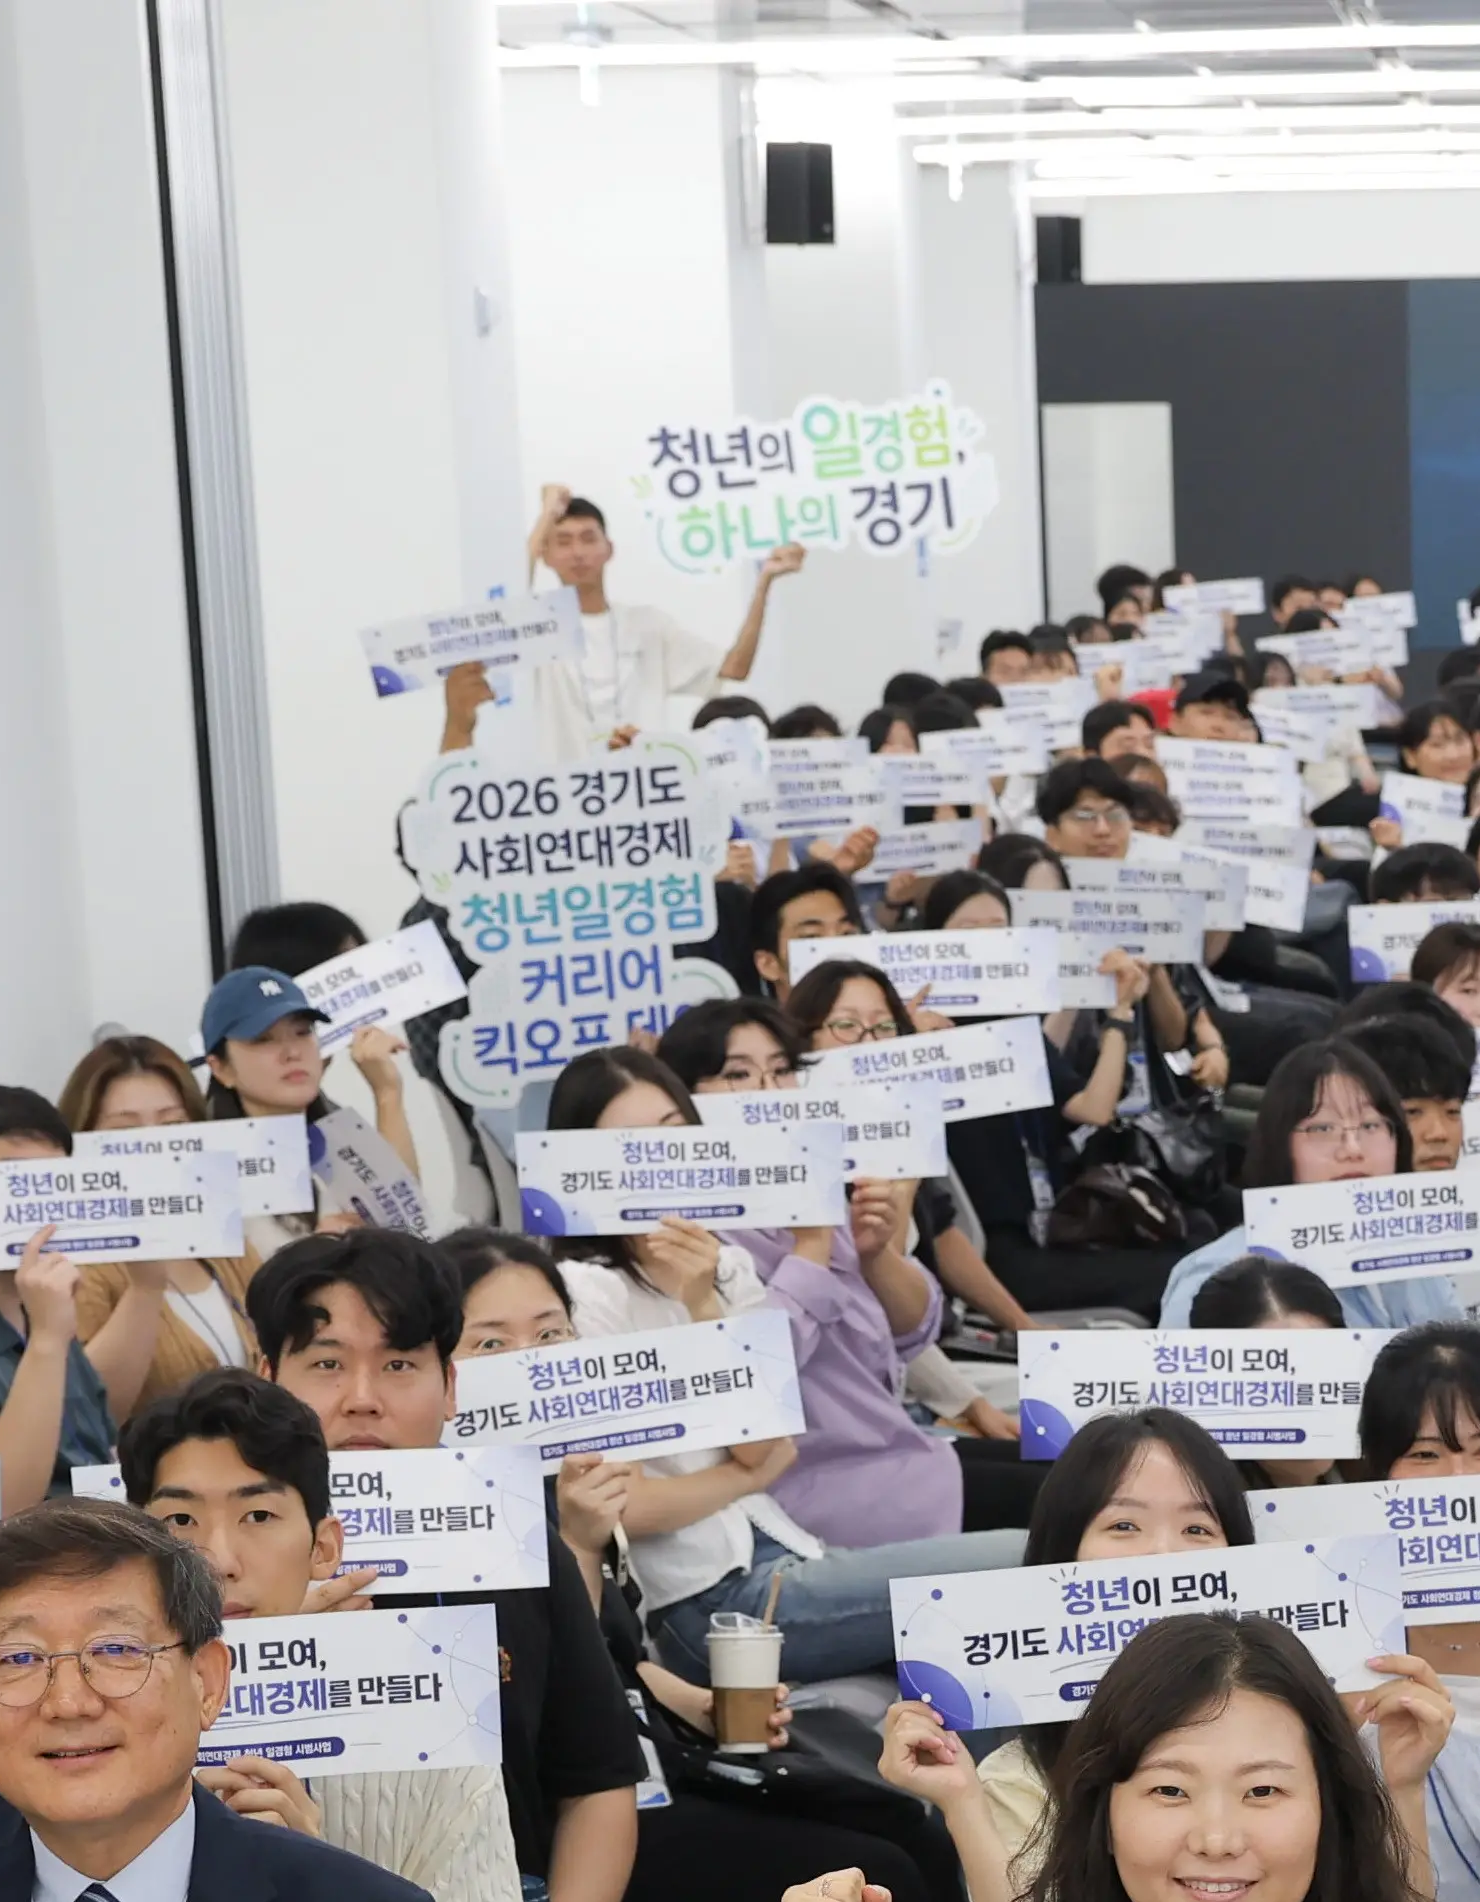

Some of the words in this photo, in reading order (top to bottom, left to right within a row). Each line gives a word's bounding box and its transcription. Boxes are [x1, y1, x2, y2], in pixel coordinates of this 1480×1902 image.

[648, 425, 795, 499] 청년의
[676, 494, 839, 559] 하나의
[850, 477, 953, 546] 경기
[451, 777, 560, 823] 2026
[570, 765, 685, 816] 경기도
[454, 817, 692, 879] 사회연대경제
[461, 872, 704, 952] 청년일경험
[520, 944, 662, 1006] 커리어
[473, 1013, 611, 1075] 킥오프
[743, 1101, 799, 1125] 청년이
[863, 1121, 910, 1141] 만들다
[622, 1140, 685, 1164] 청년이
[692, 1140, 736, 1163] 모여,
[7, 1172, 75, 1197] 청년이
[81, 1171, 128, 1193] 모여,
[561, 1171, 614, 1192] 경기도
[617, 1167, 752, 1190] 사회연대경제를
[755, 1165, 808, 1184] 만들다
[3, 1197, 145, 1224] 사회연대경제를
[148, 1195, 204, 1215] 만들다
[1353, 1188, 1415, 1215] 청년이
[1420, 1185, 1463, 1207] 모여,
[1291, 1224, 1345, 1248] 경기도
[1349, 1211, 1478, 1241] 사회연대경제를
[528, 1355, 607, 1391] 청년이
[613, 1348, 666, 1376] 모여,
[1153, 1345, 1233, 1374] 청년이
[1242, 1348, 1296, 1375] 모여,
[454, 1402, 522, 1437] 경기도
[529, 1378, 687, 1422] 사회연대경제를
[690, 1366, 753, 1396] 만들다
[1073, 1381, 1140, 1407] 경기도
[1146, 1381, 1315, 1407] 사회연대경제를
[331, 1472, 392, 1501] 모여,
[420, 1505, 495, 1532] 만들다
[1386, 1495, 1477, 1530] 청년이
[1062, 1577, 1161, 1615] 청년이
[1172, 1571, 1237, 1603] 모여,
[1421, 1591, 1470, 1603] 사회연대경제
[964, 1628, 1049, 1666] 경기도
[1268, 1600, 1348, 1633] 만들다
[259, 1638, 326, 1671] 모여,
[358, 1673, 442, 1705] 만들다
[266, 1745, 292, 1757] 일경험
[296, 1742, 331, 1755] 시범사업
